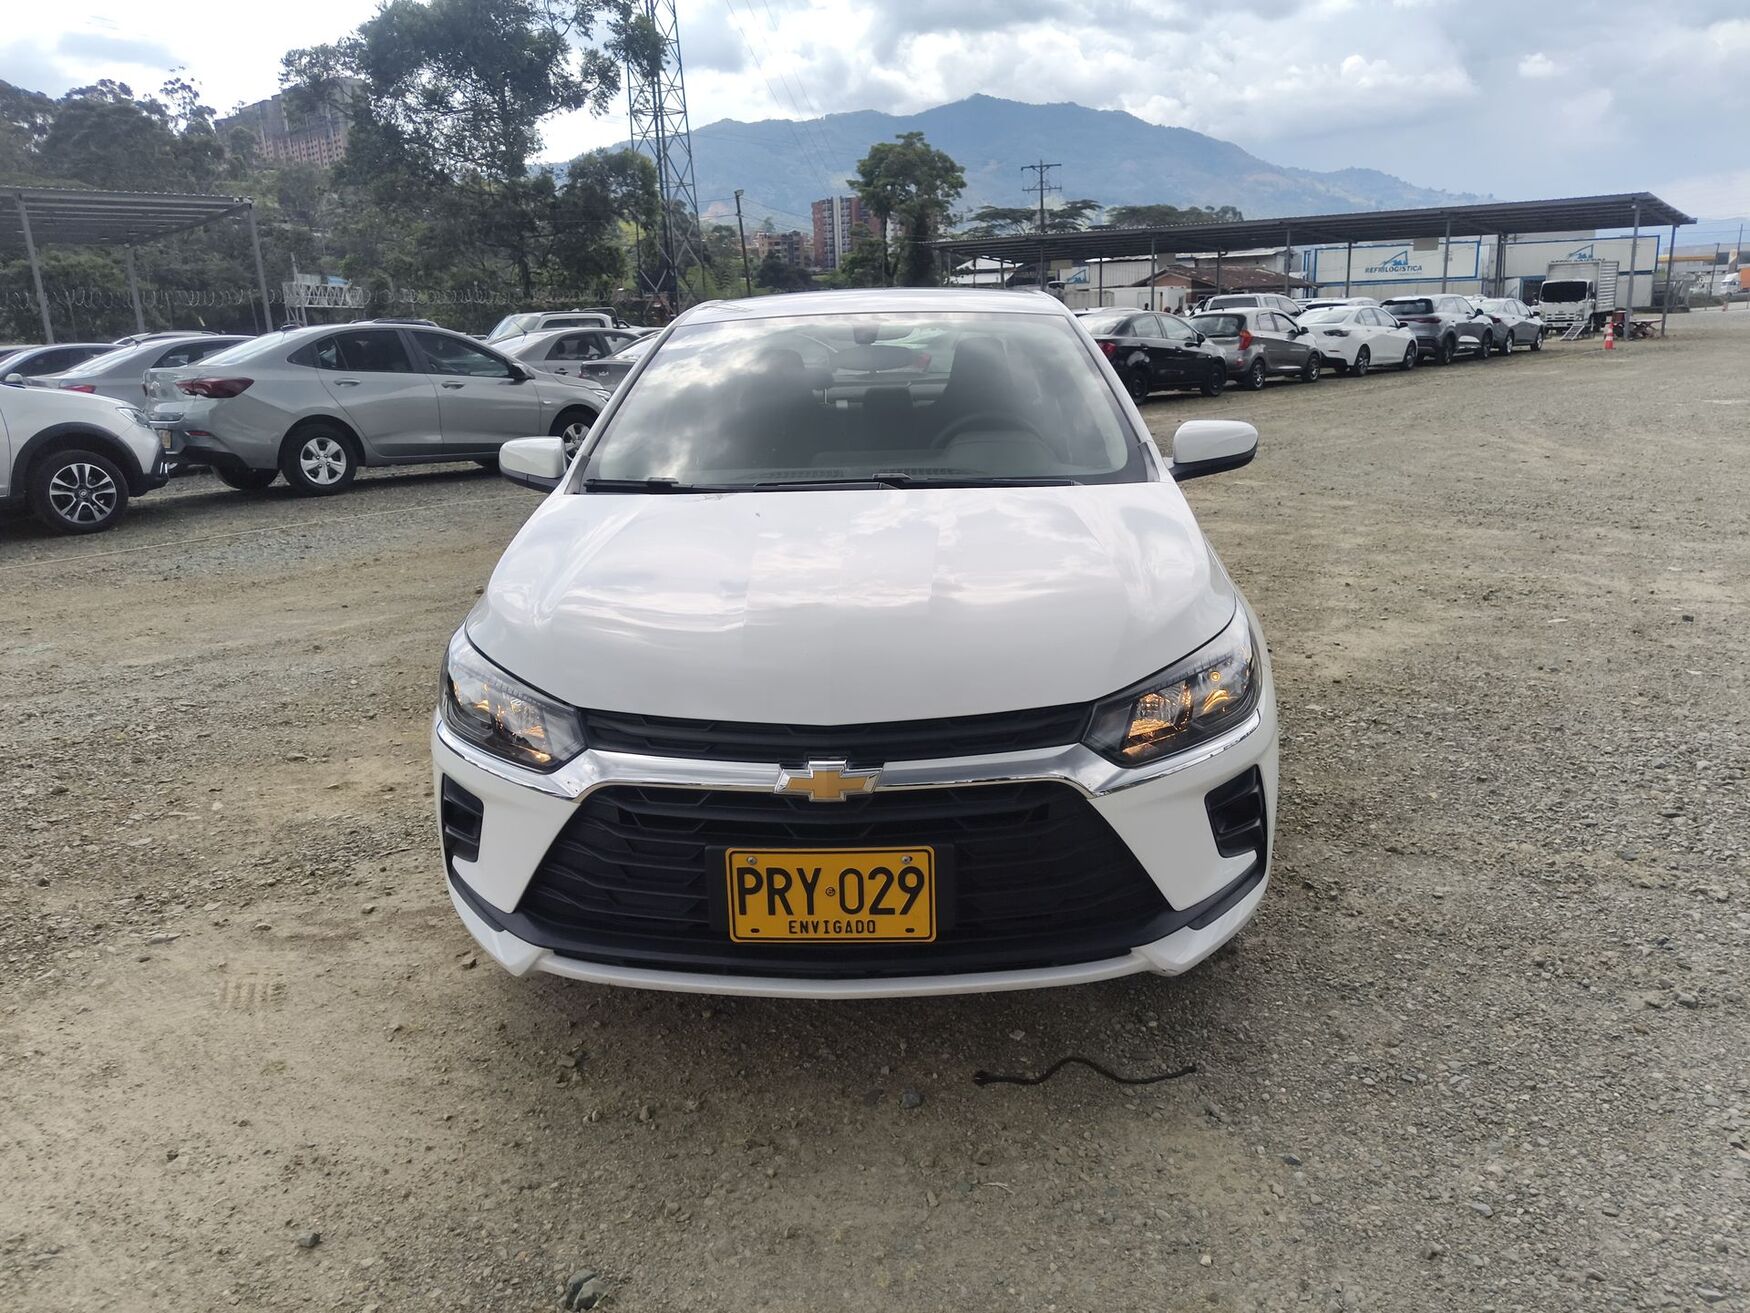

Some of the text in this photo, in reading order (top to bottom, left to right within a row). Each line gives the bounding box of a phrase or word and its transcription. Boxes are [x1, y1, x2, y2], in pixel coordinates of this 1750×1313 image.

[736, 866, 925, 916] PRY 029
[788, 919, 877, 935] ENVIGADO
